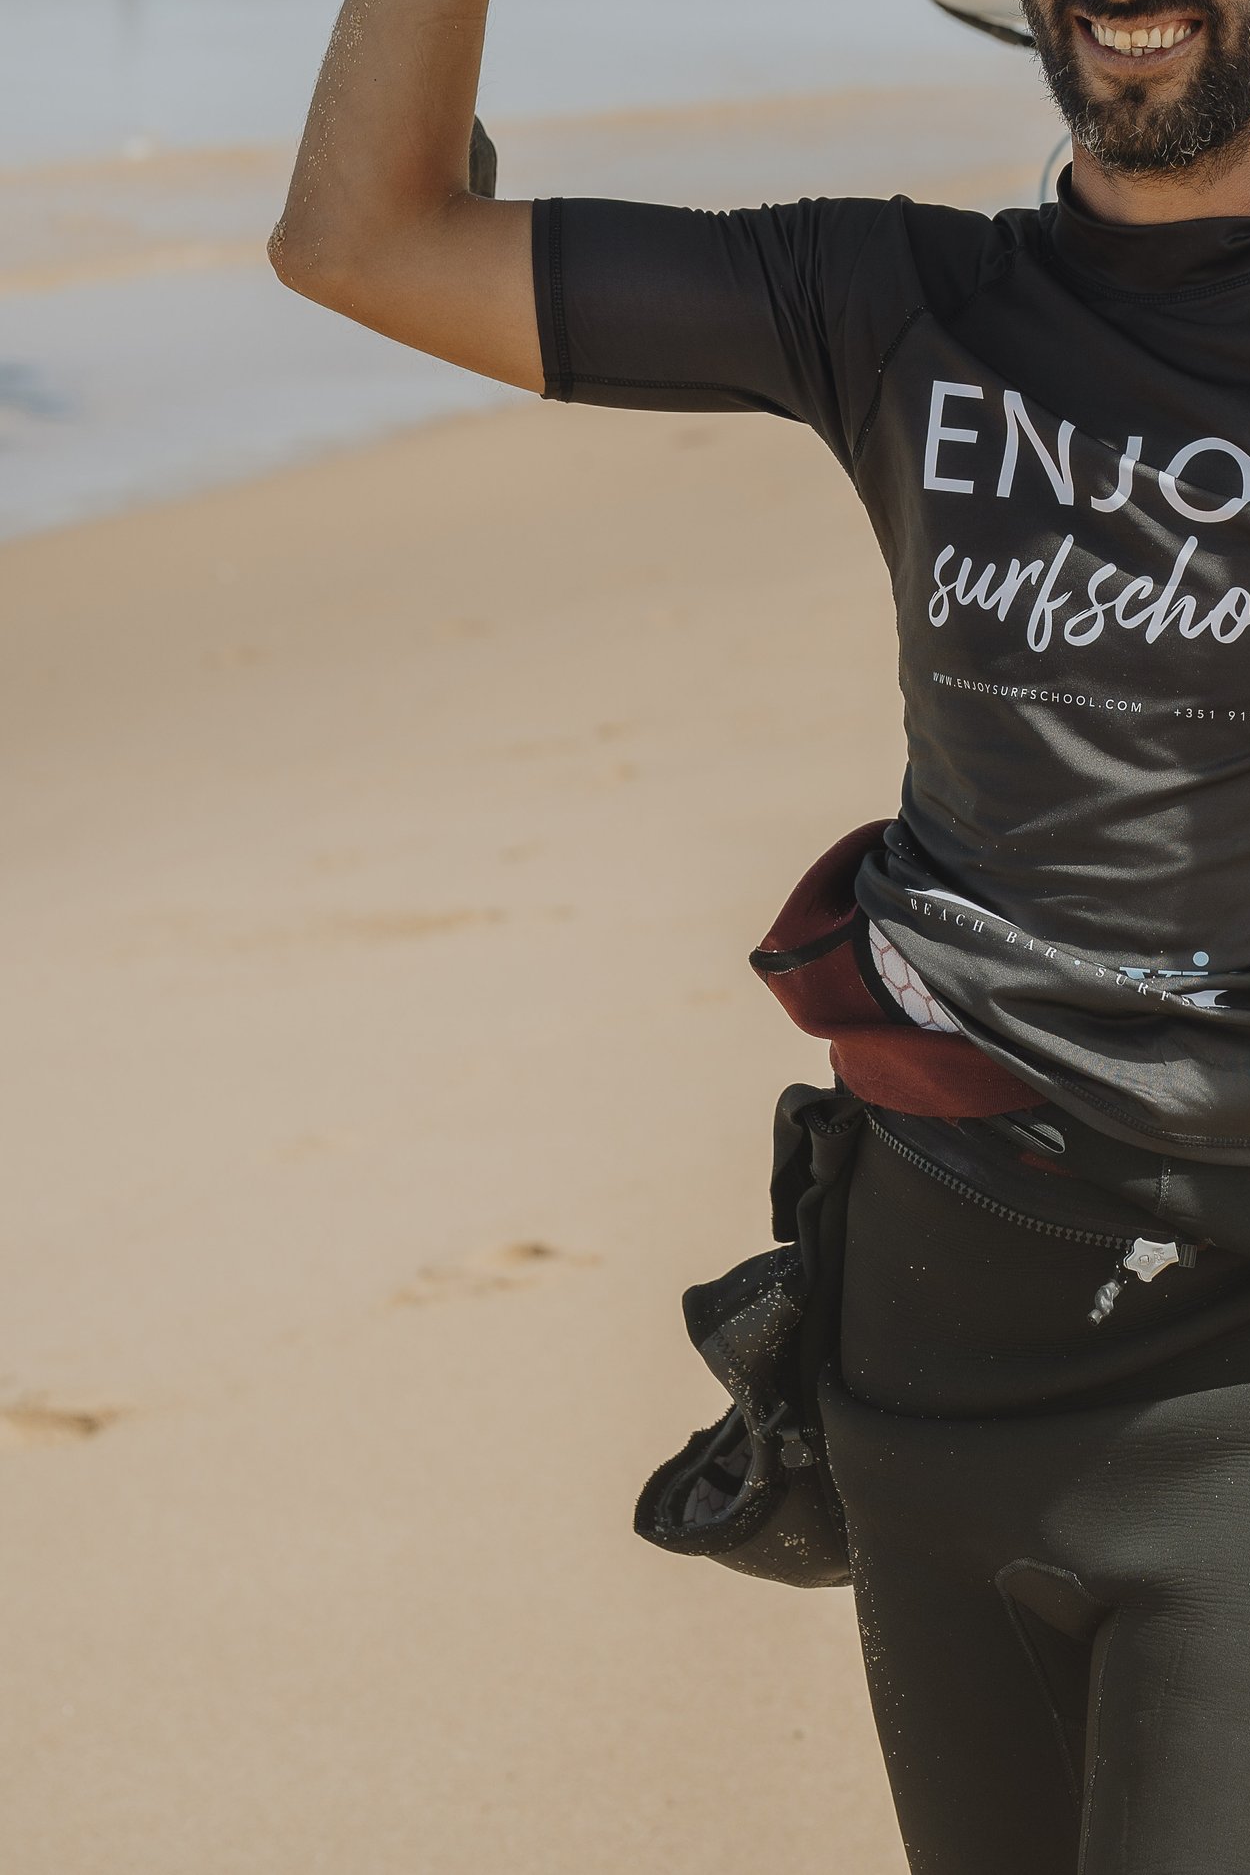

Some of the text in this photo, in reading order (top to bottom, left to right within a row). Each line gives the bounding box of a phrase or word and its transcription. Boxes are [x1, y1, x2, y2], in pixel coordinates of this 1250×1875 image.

[932, 671, 1142, 713] WWW.ENJOYSURFSCHOOL.COM
[1174, 708, 1215, 720] +351
[910, 898, 985, 933] BEACH
[1005, 931, 1058, 959] BAR
